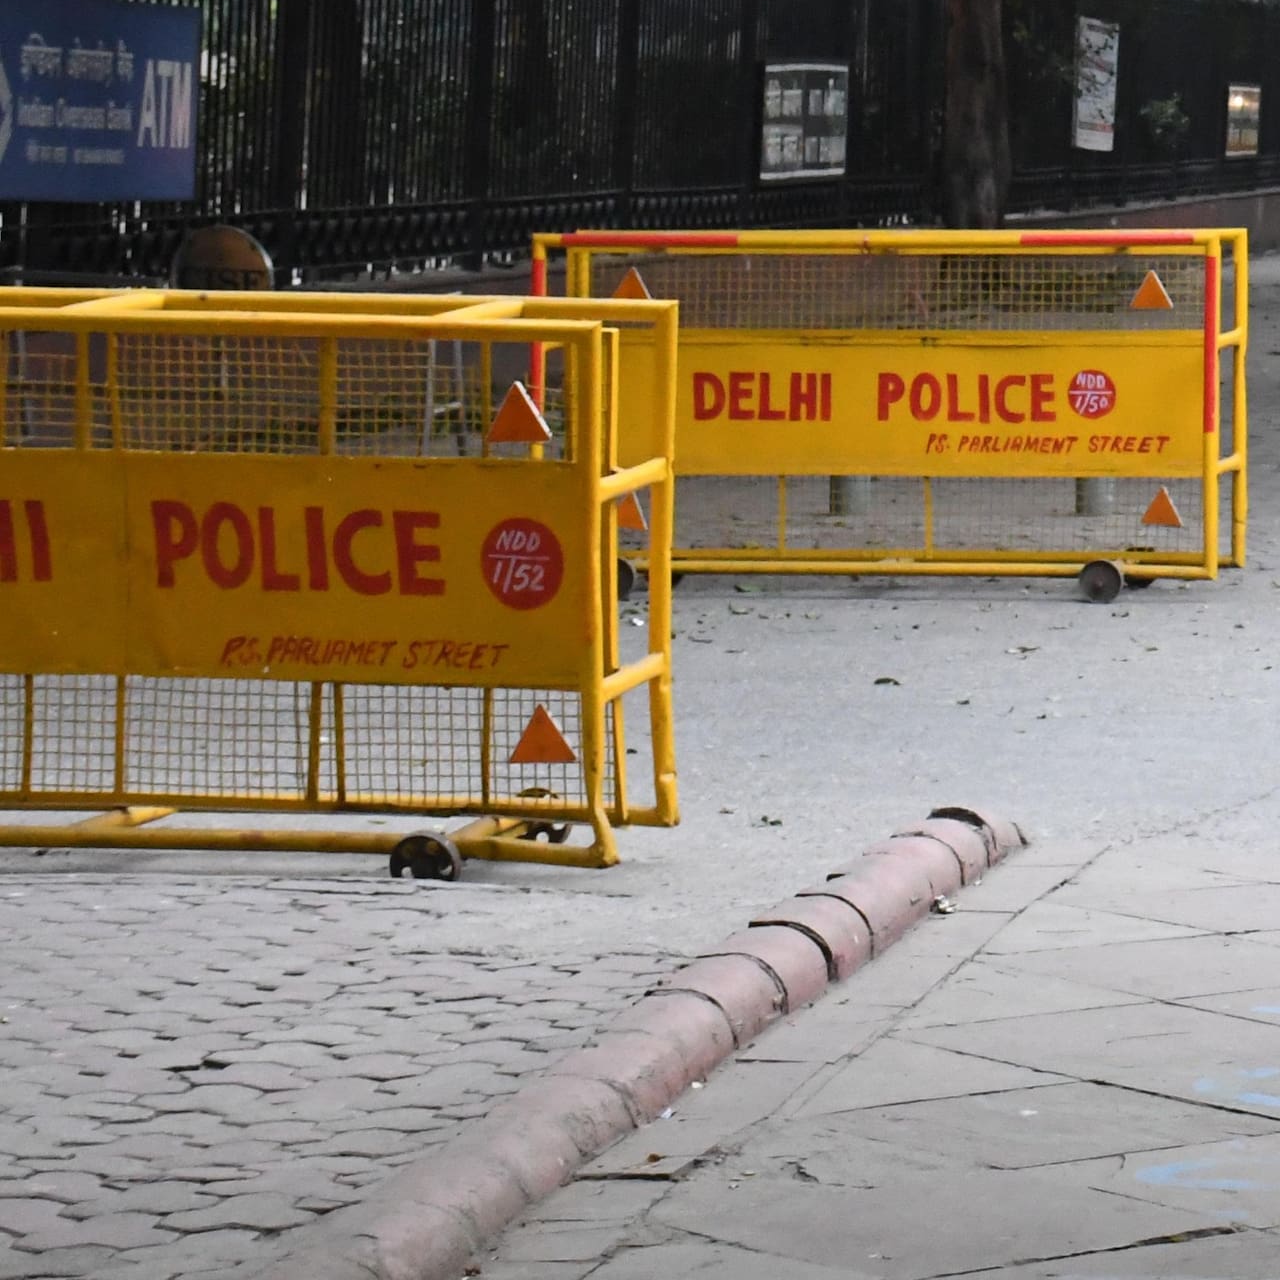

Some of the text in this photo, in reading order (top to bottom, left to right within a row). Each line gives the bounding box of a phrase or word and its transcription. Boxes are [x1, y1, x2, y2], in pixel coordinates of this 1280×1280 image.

[137, 58, 192, 149] ATM
[692, 372, 1057, 424] DELHI POLICE
[957, 435, 1079, 455] PARLIAMENT
[1087, 435, 1170, 455] STREET
[151, 500, 446, 596] POLICE
[495, 530, 541, 553] NDD
[402, 640, 510, 669] STREET
